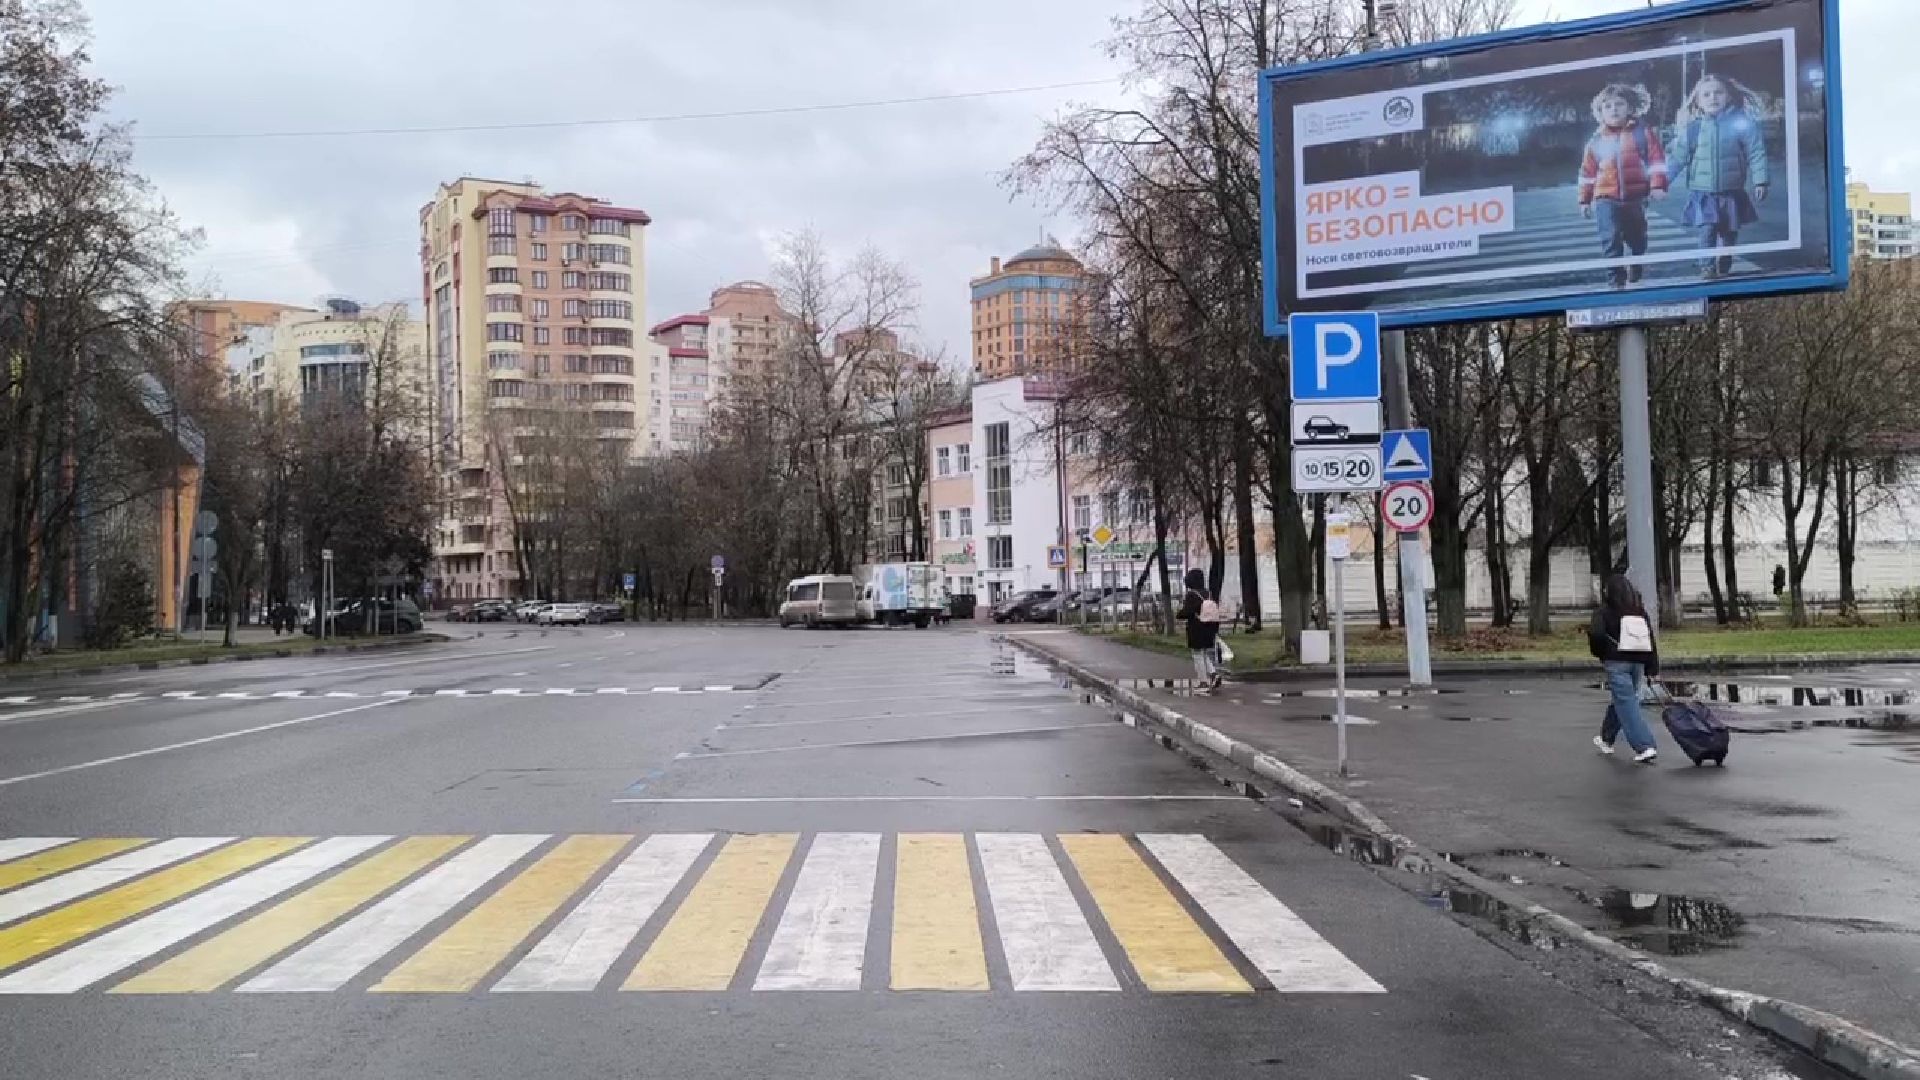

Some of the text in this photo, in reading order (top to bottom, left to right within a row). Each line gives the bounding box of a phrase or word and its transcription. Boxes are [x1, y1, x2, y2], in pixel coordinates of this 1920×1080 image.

[1306, 185, 1409, 215] ЯРКО =
[1306, 199, 1504, 245] БЕЗОПАСНО
[1306, 239, 1472, 266] Носи световозвращатели
[1315, 322, 1362, 391] P
[1305, 460, 1371, 478] 10 15 20
[1392, 496, 1422, 517] 20
